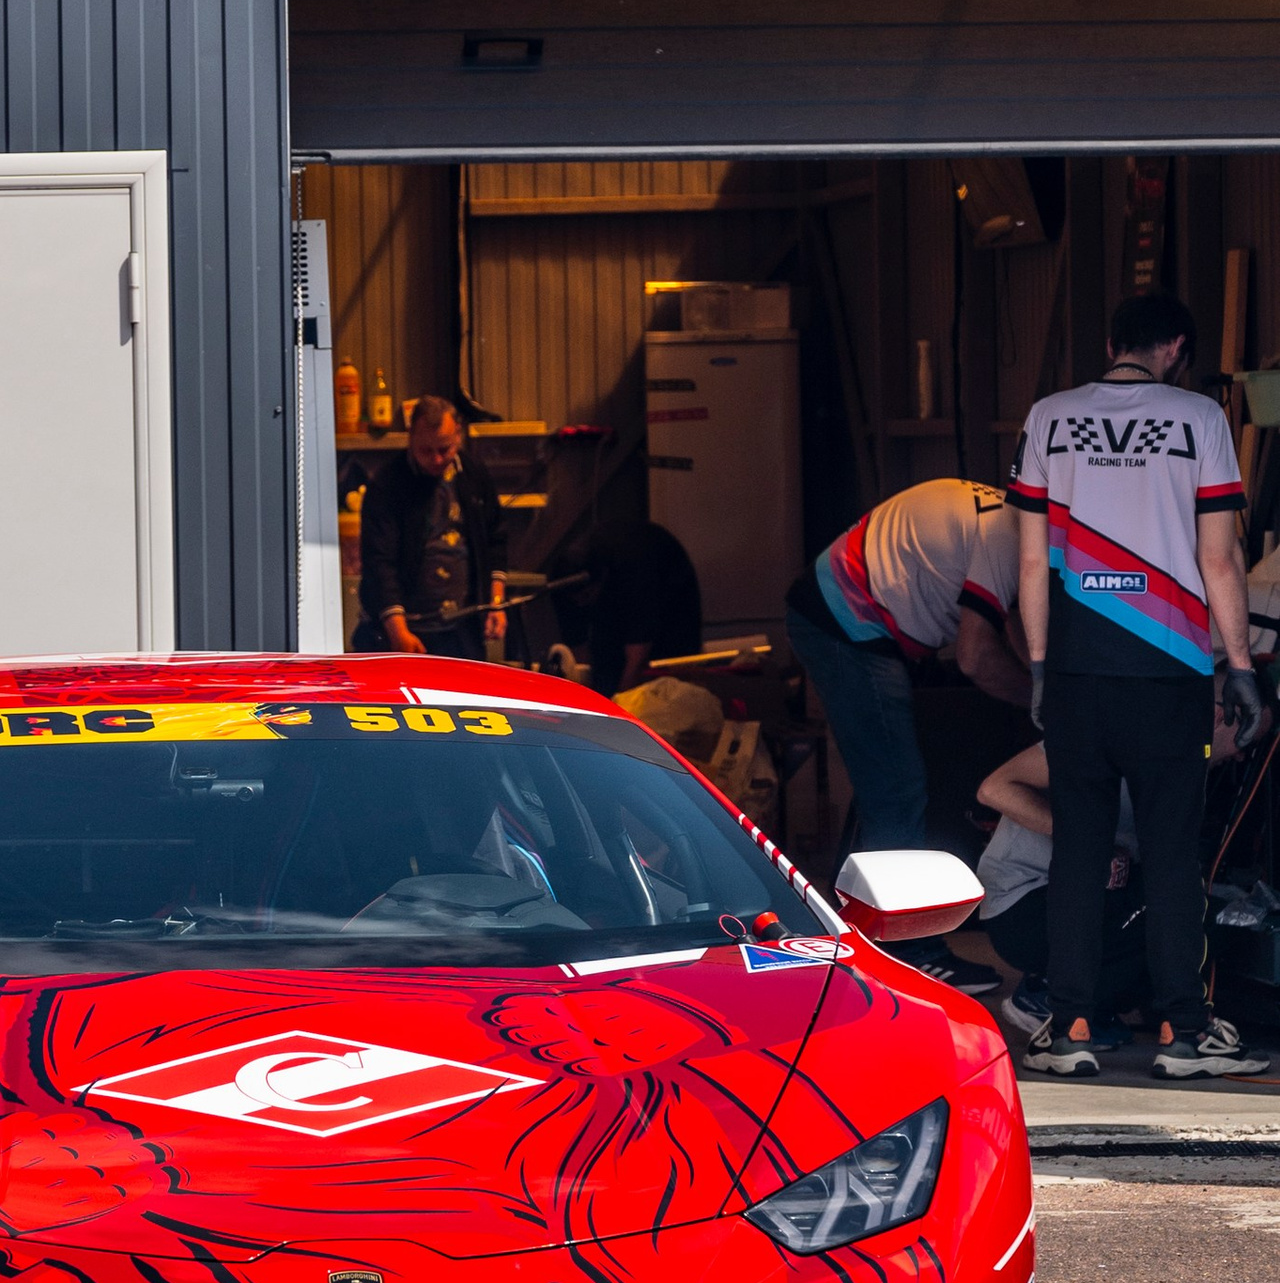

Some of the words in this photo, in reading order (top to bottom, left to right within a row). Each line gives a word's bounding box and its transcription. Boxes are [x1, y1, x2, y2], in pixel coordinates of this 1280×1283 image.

[1088, 456, 1122, 468] RACING
[1124, 457, 1147, 468] TEAM
[1082, 574, 1145, 589] AIMOL
[344, 706, 514, 736] 503
[332, 1273, 379, 1282] LAMBORGHINI
